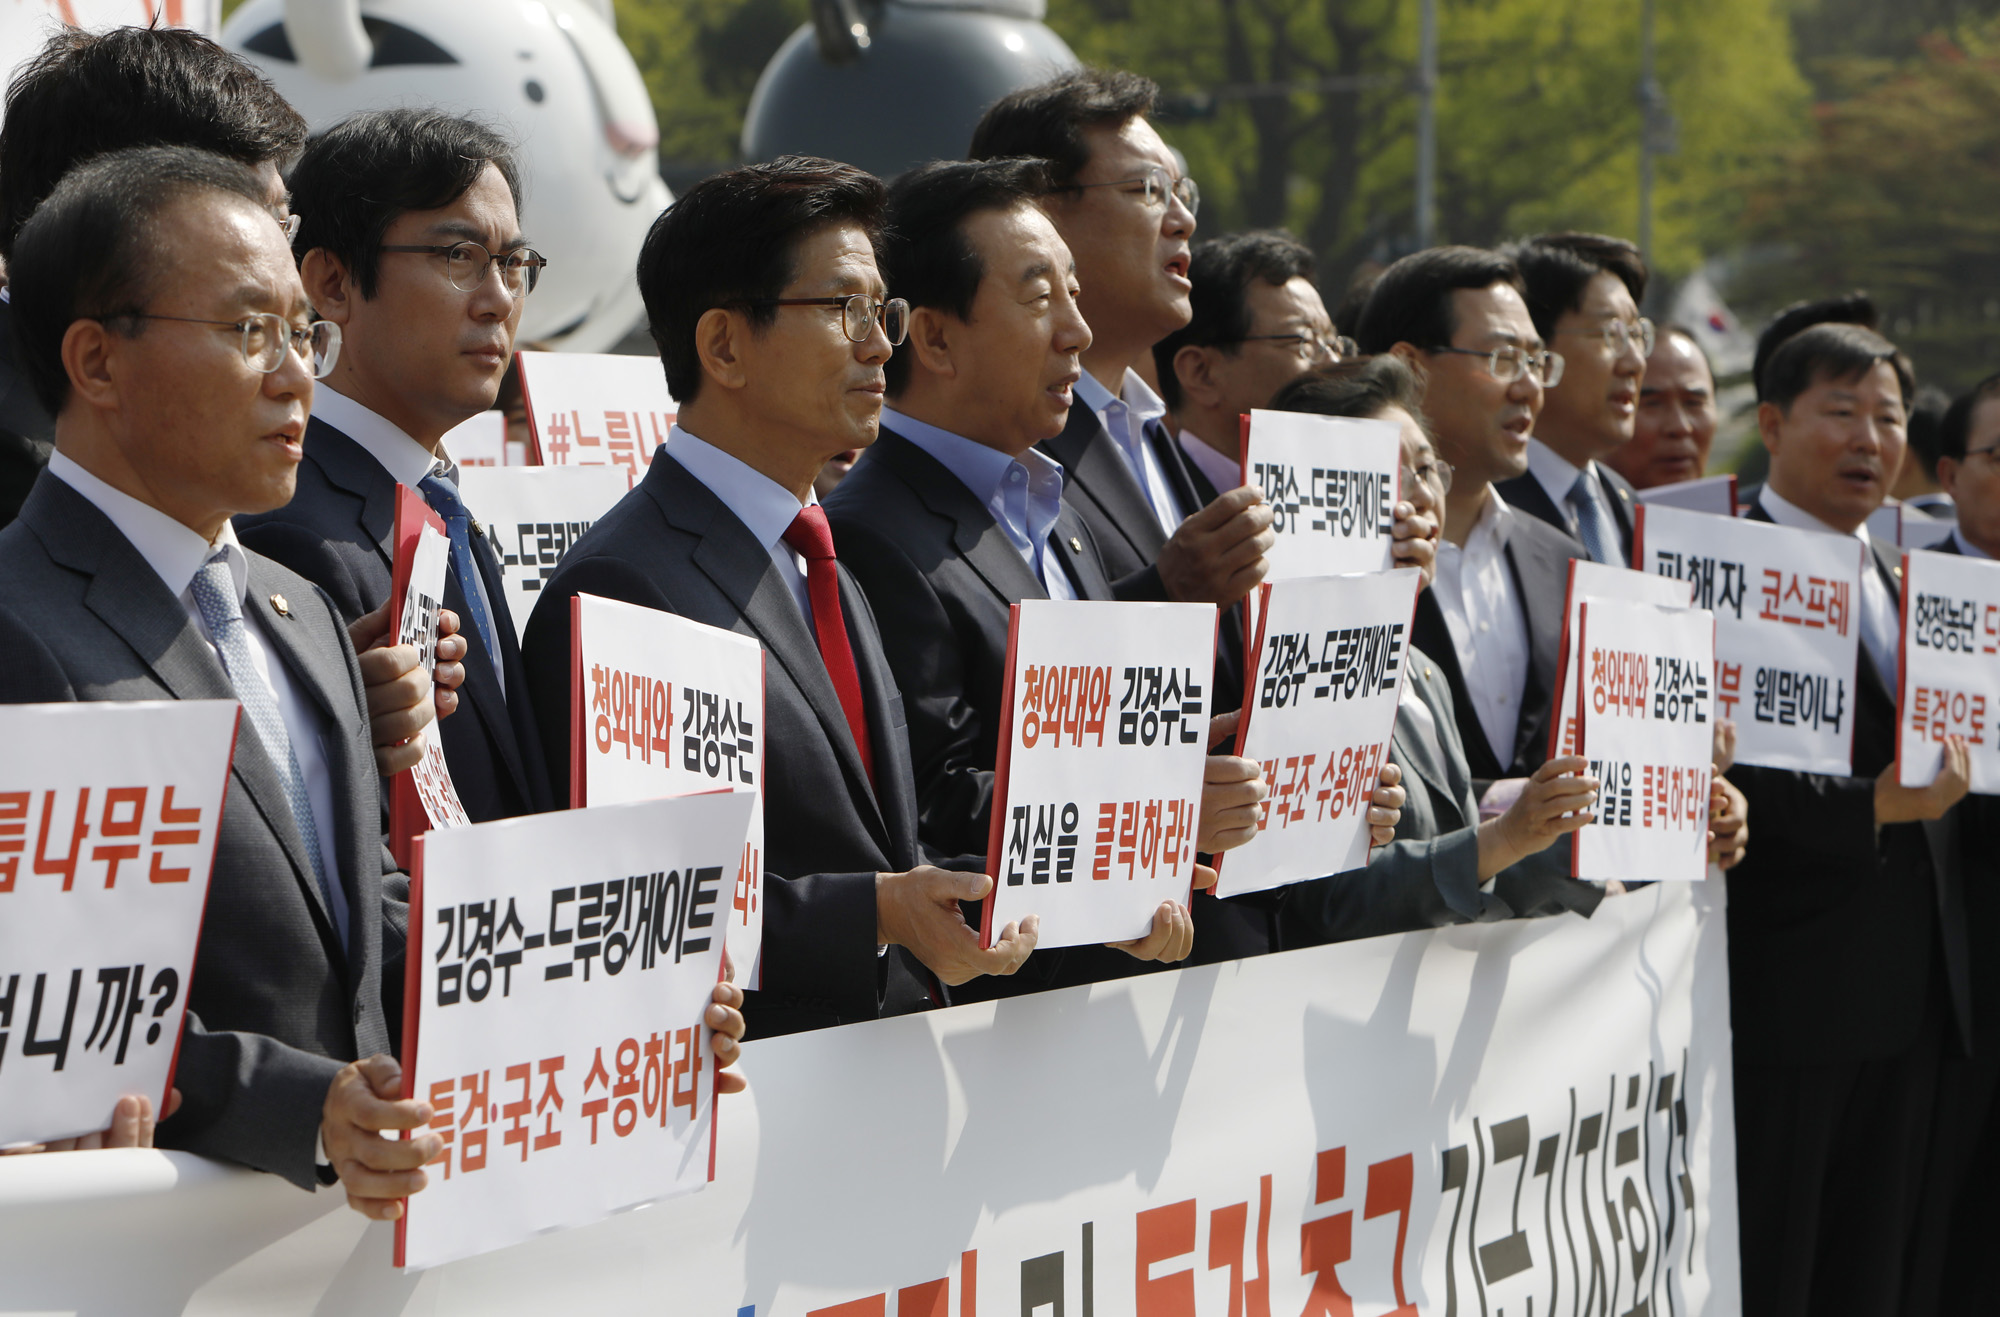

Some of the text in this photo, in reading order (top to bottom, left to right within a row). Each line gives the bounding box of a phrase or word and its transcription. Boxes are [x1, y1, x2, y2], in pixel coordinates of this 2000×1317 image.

[1759, 567, 1850, 638] 코스프레
[1982, 604, 2000, 654] 드
[1021, 664, 1202, 749] 청와대와 김경수는
[1260, 623, 1405, 709] 김경수-드루킹게이트
[1591, 647, 1708, 724] 청와대와 김경수는
[1754, 666, 1845, 735] 웬말이냐
[591, 662, 754, 785] 청와대와 김경수는
[1912, 686, 1986, 745] 특검으로
[1316, 742, 1383, 823] 수용하라
[1642, 765, 1706, 832] 클릭하라!
[1006, 798, 1195, 887] 진실을 클릭하라!
[435, 865, 724, 1007] 김경수-드루킹게이트
[0, 964, 179, 1073] 니까?
[580, 1023, 703, 1146] 수용하라
